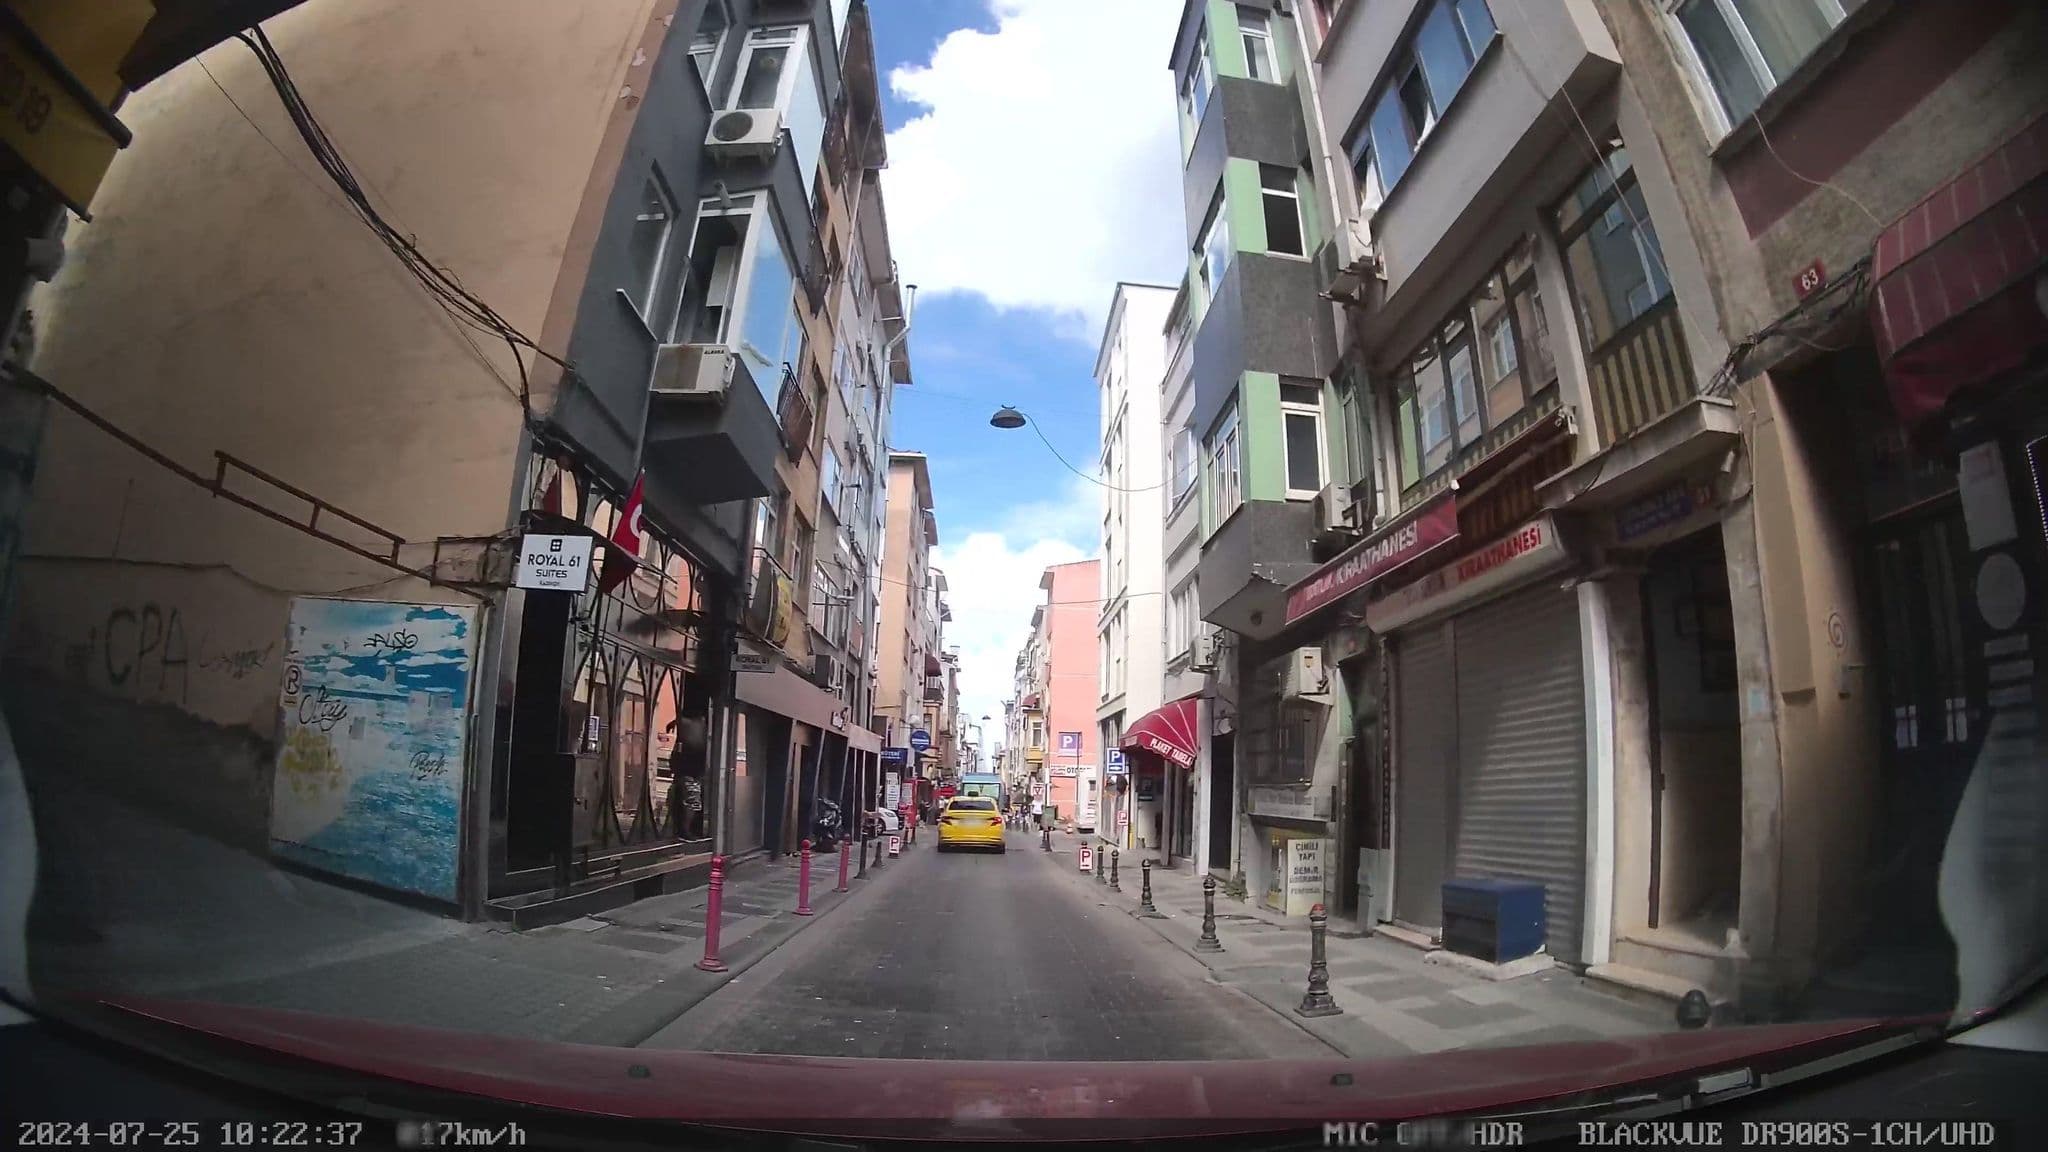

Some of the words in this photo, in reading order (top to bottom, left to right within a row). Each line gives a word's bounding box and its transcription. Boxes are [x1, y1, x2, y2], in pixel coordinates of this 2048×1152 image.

[1802, 269, 1818, 290] 63
[527, 553, 565, 567] ROYAL
[568, 555, 581, 568] 61
[536, 569, 568, 578] SUITES
[1062, 735, 1073, 748] P
[1111, 751, 1120, 762] P
[890, 838, 898, 848] P
[1082, 850, 1090, 863] P
